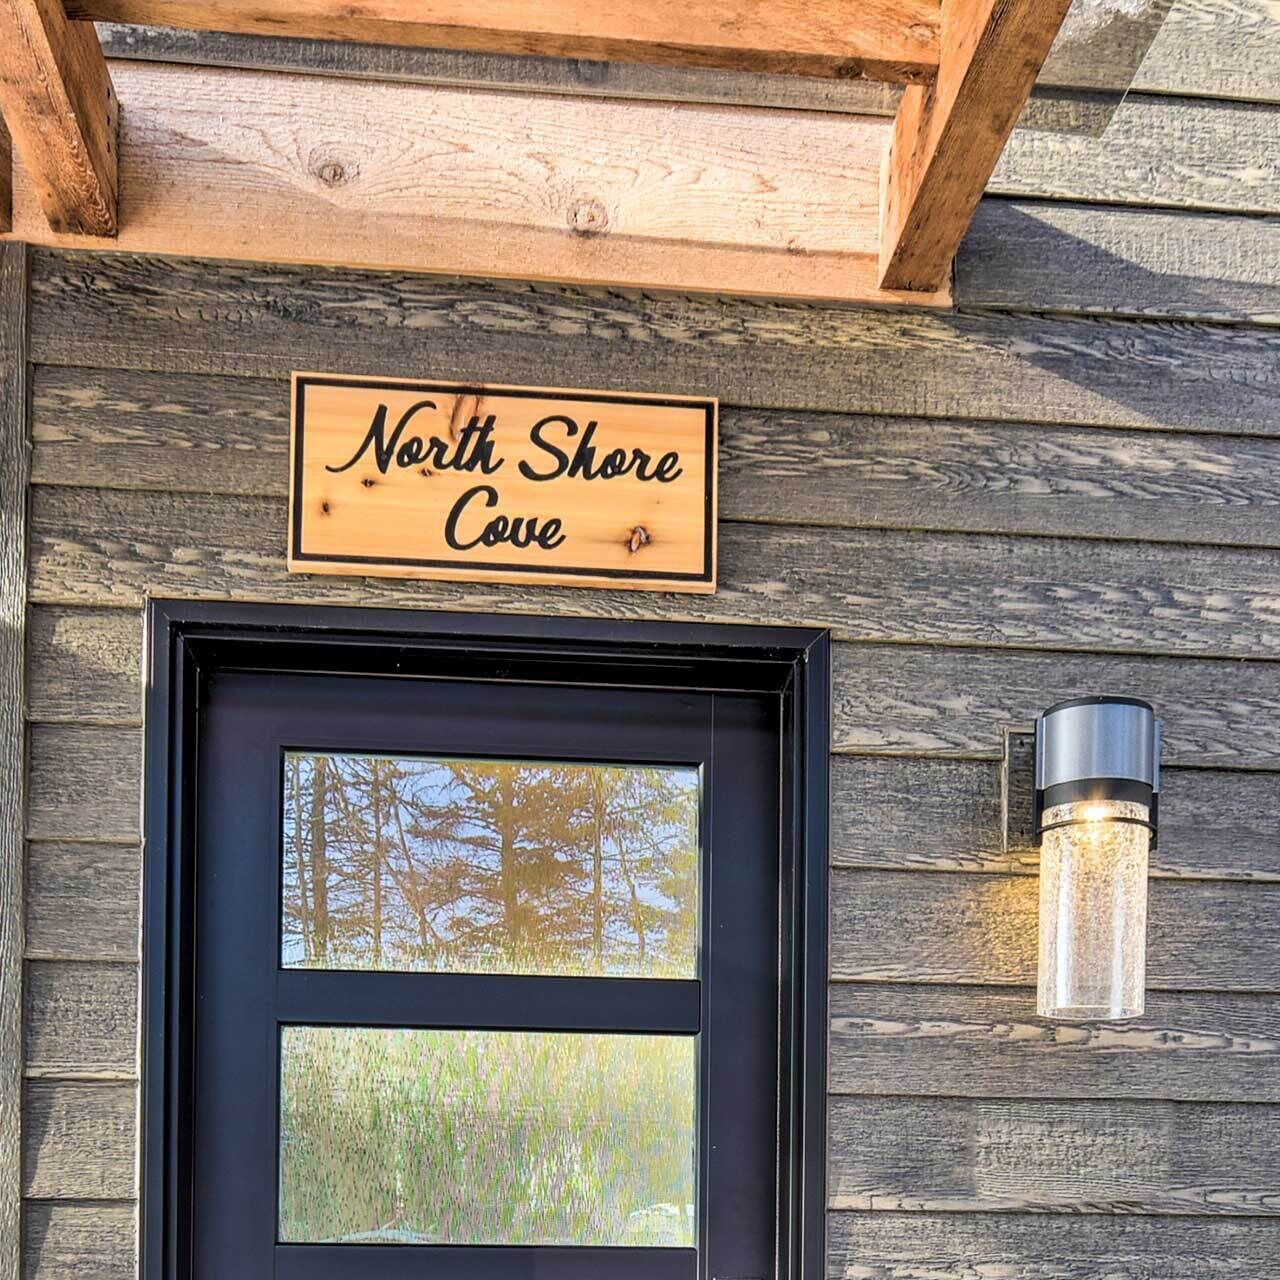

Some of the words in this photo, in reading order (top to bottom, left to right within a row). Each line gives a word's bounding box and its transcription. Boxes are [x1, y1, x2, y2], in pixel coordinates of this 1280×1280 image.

[325, 400, 505, 475] North
[518, 414, 683, 484] Shore
[444, 484, 568, 551] Cove
